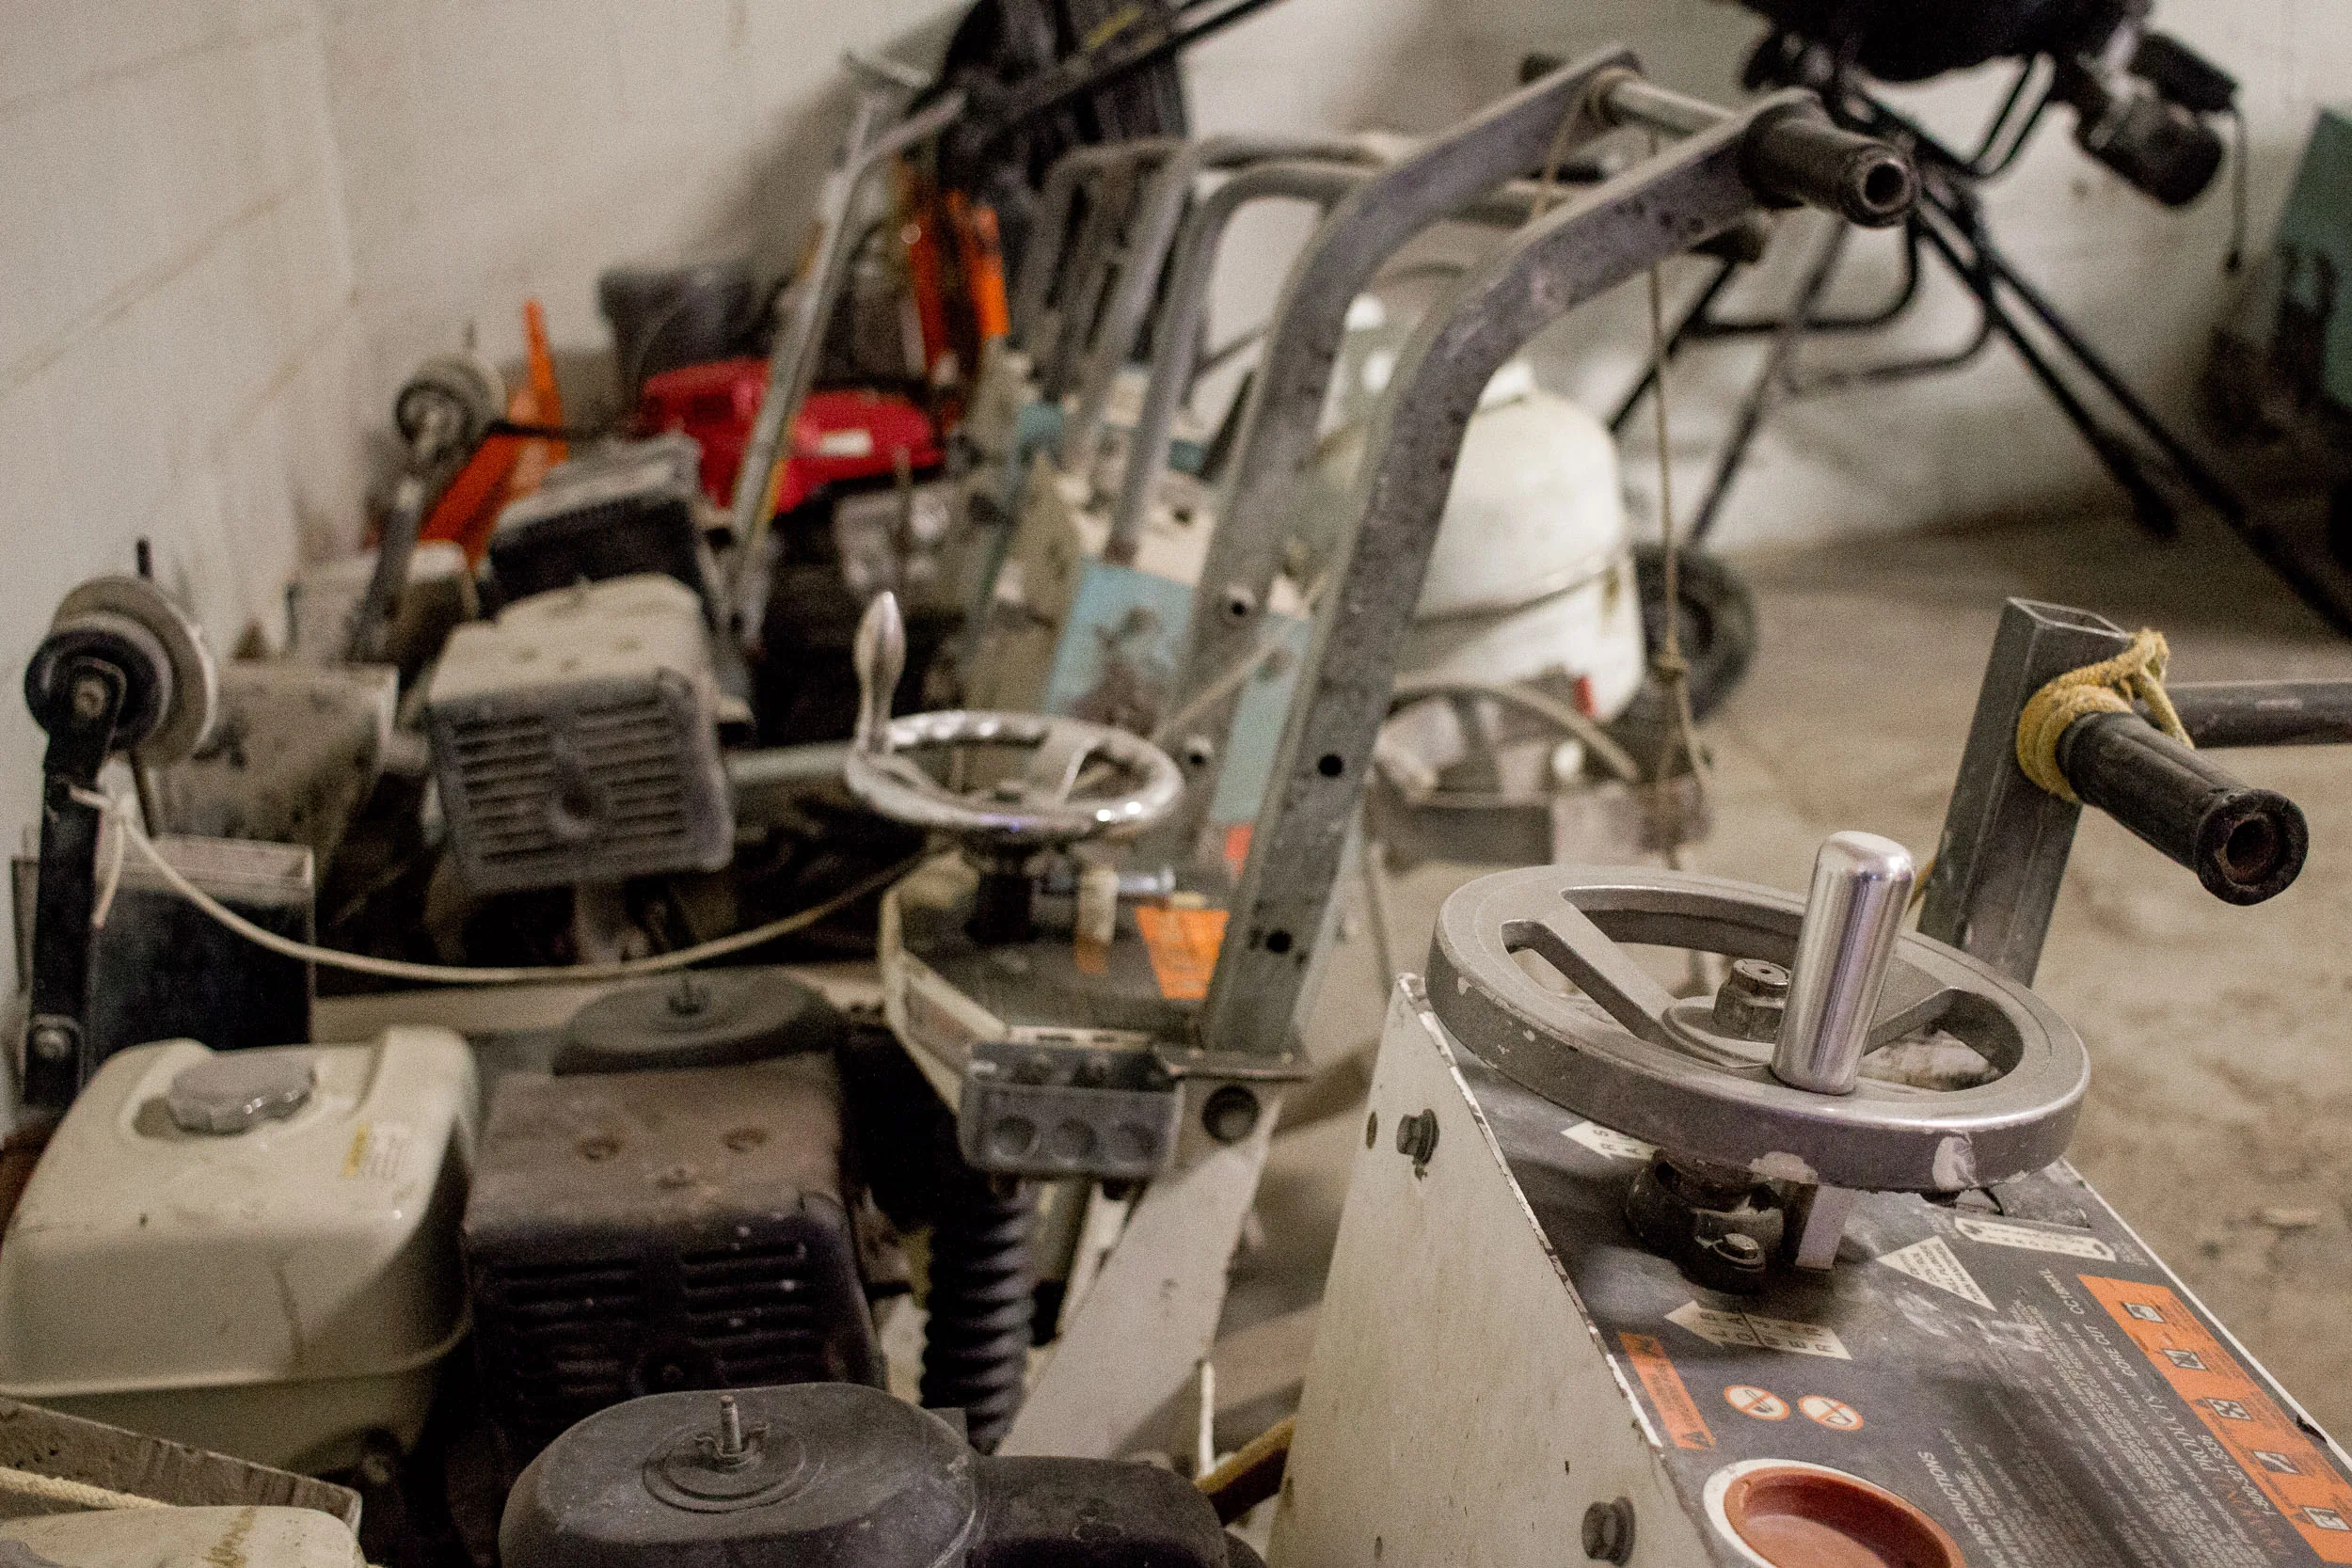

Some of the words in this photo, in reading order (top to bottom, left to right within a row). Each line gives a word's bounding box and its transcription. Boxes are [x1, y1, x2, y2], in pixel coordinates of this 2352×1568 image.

[1706, 1325, 1836, 1354] LOWER
[2080, 1323, 2113, 1345] CUT
[2100, 1346, 2141, 1378] CORE
[2137, 1393, 2221, 1471] PRODUCTS
[1915, 1449, 1996, 1546] INSTRUCTIONS
[2193, 1433, 2281, 1517] 1-800-321-5336
[1984, 1517, 2035, 1568] ARTING
[2110, 1521, 2162, 1568] AWING:
